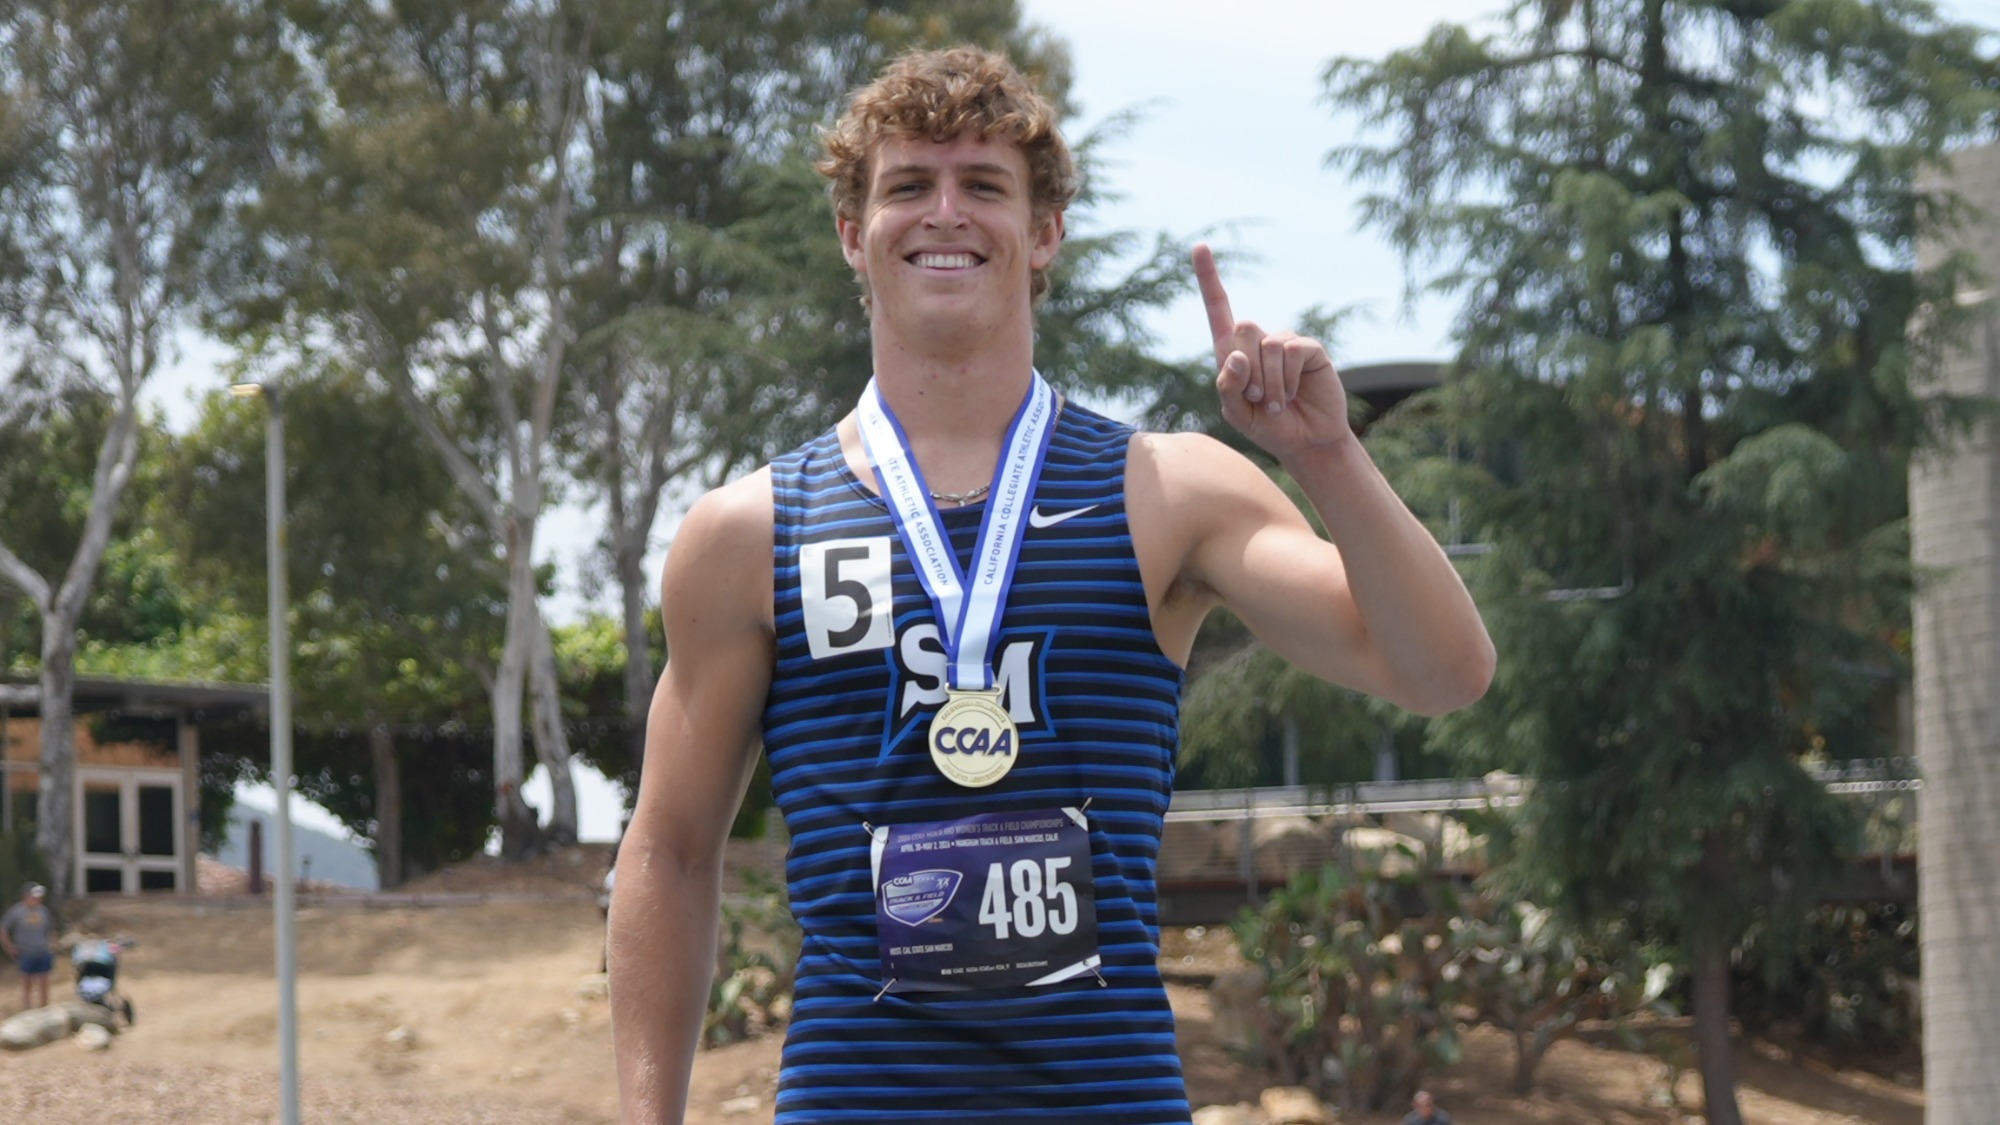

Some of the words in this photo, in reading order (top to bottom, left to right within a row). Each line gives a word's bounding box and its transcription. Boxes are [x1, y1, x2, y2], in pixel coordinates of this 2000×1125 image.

[984, 523, 1007, 585] CALIFORNIA
[1003, 463, 1024, 520] COLLEGIATE
[1017, 424, 1036, 463] ATHLETIC
[916, 521, 949, 587] ASSOCIATION
[825, 546, 873, 648] 5
[935, 727, 1011, 756] CCAA
[955, 824, 981, 834] WOMEN'S
[982, 822, 999, 832] TRACK
[1005, 821, 1020, 831] FIELD
[1021, 818, 1064, 830] CHAMPIONSHIPS
[980, 837, 994, 846] TRACK
[893, 876, 913, 885] CCAA
[889, 896, 914, 905] TRACK
[922, 891, 945, 899] FIELD
[978, 856, 1079, 939] 485
